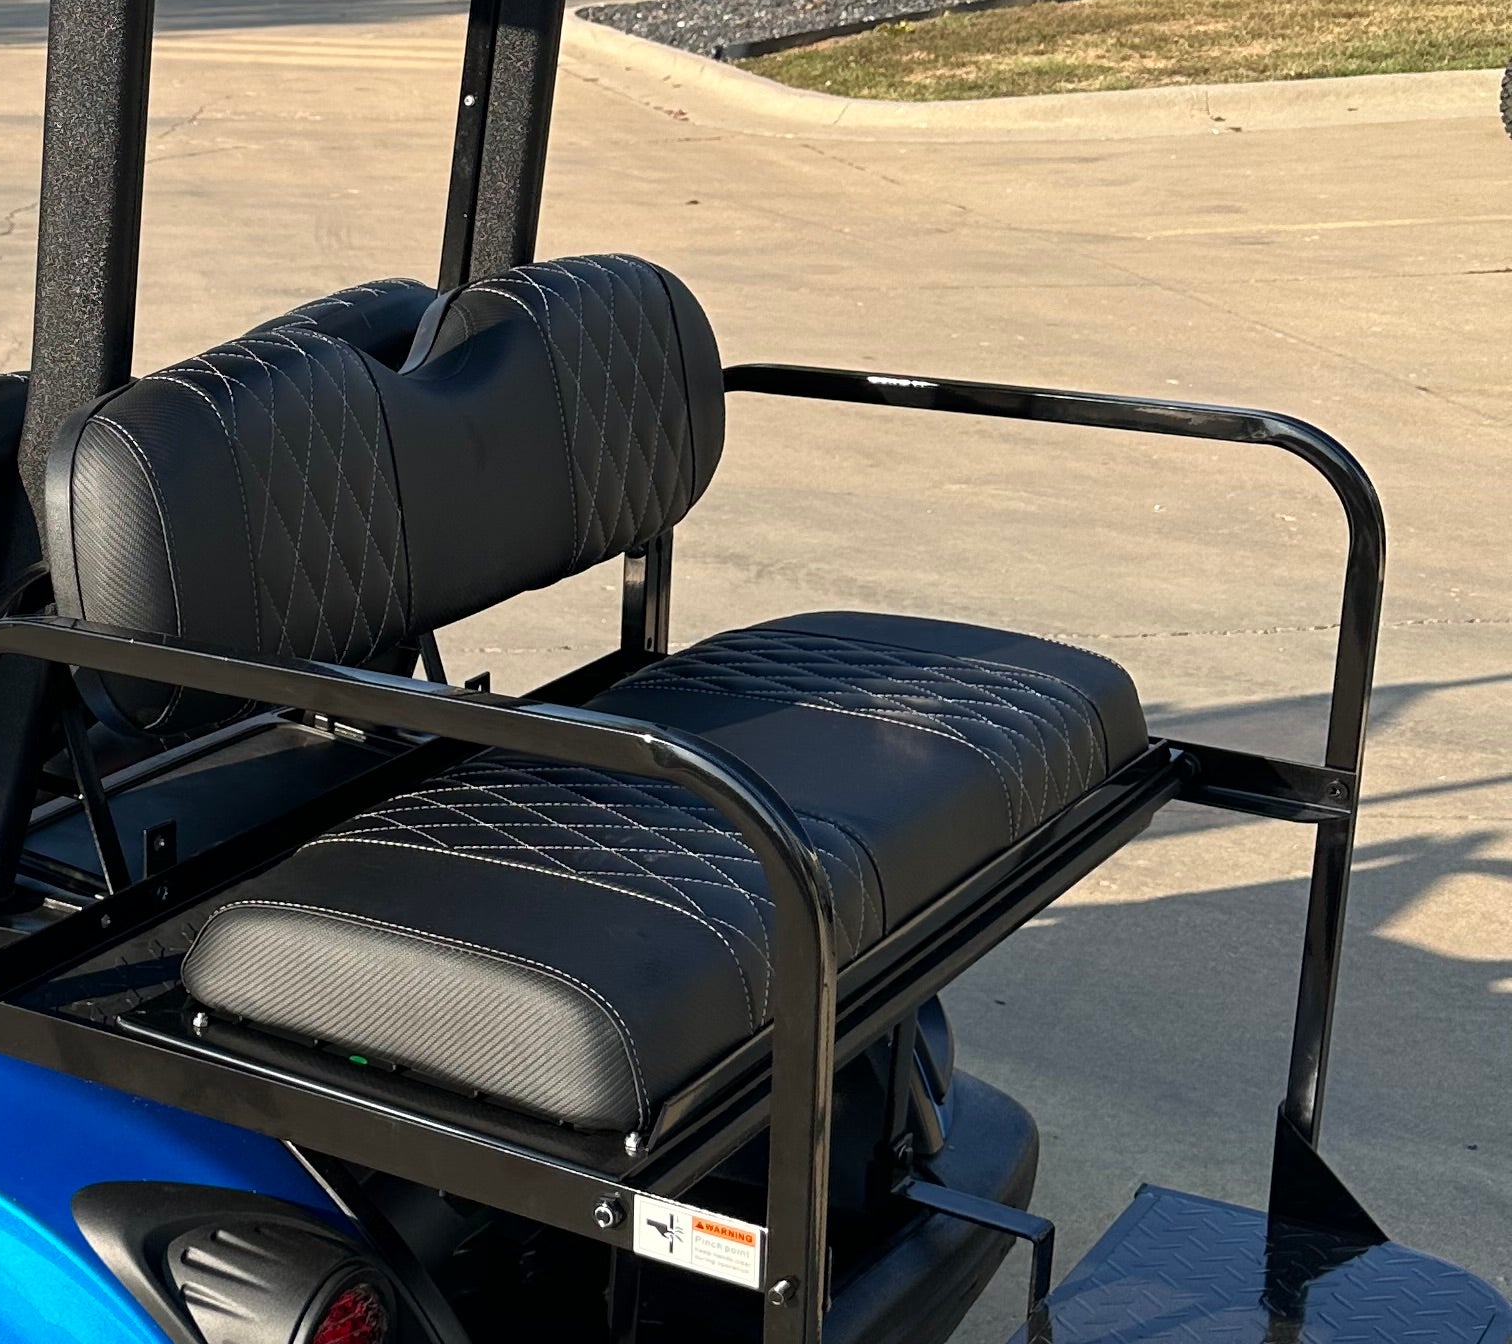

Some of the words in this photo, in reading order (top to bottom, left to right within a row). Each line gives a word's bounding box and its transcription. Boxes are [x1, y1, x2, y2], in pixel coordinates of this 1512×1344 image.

[705, 1223, 753, 1243] WARNING
[695, 1235, 723, 1249] Pinch
[724, 1246, 750, 1258] point
